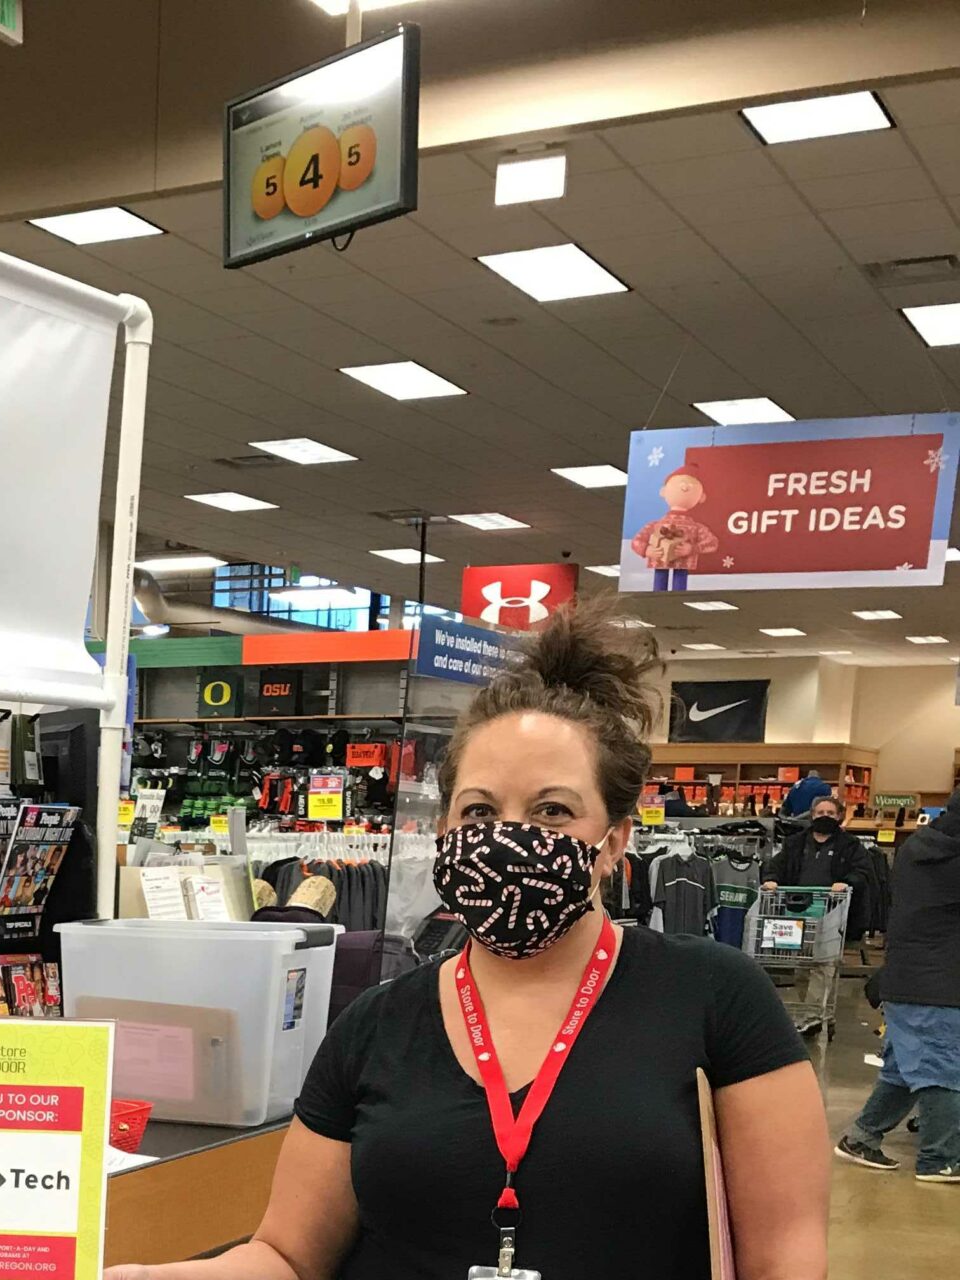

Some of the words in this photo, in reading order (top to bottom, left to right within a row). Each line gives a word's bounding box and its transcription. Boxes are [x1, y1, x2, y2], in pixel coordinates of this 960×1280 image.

[348, 144, 361, 166] 5
[299, 153, 324, 189] 4
[265, 175, 278, 197] 5
[767, 468, 872, 497] FRESH
[727, 508, 800, 535] GIFT
[808, 504, 907, 532] IDEAS
[435, 629, 455, 649] We've
[455, 633, 483, 654] installed
[433, 654, 448, 669] and
[448, 658, 463, 671] care
[203, 681, 232, 706] O
[262, 683, 291, 696] OSU
[772, 923, 794, 931] Save
[581, 967, 601, 995] Door
[460, 984, 475, 1014] Store
[577, 995, 590, 1010] to
[466, 1011, 478, 1026] to
[562, 1009, 584, 1036] Store
[470, 1024, 485, 1048] Door
[7, 1093, 27, 1106] TO
[29, 1094, 60, 1107] OUR
[9, 1167, 71, 1191] Tech
